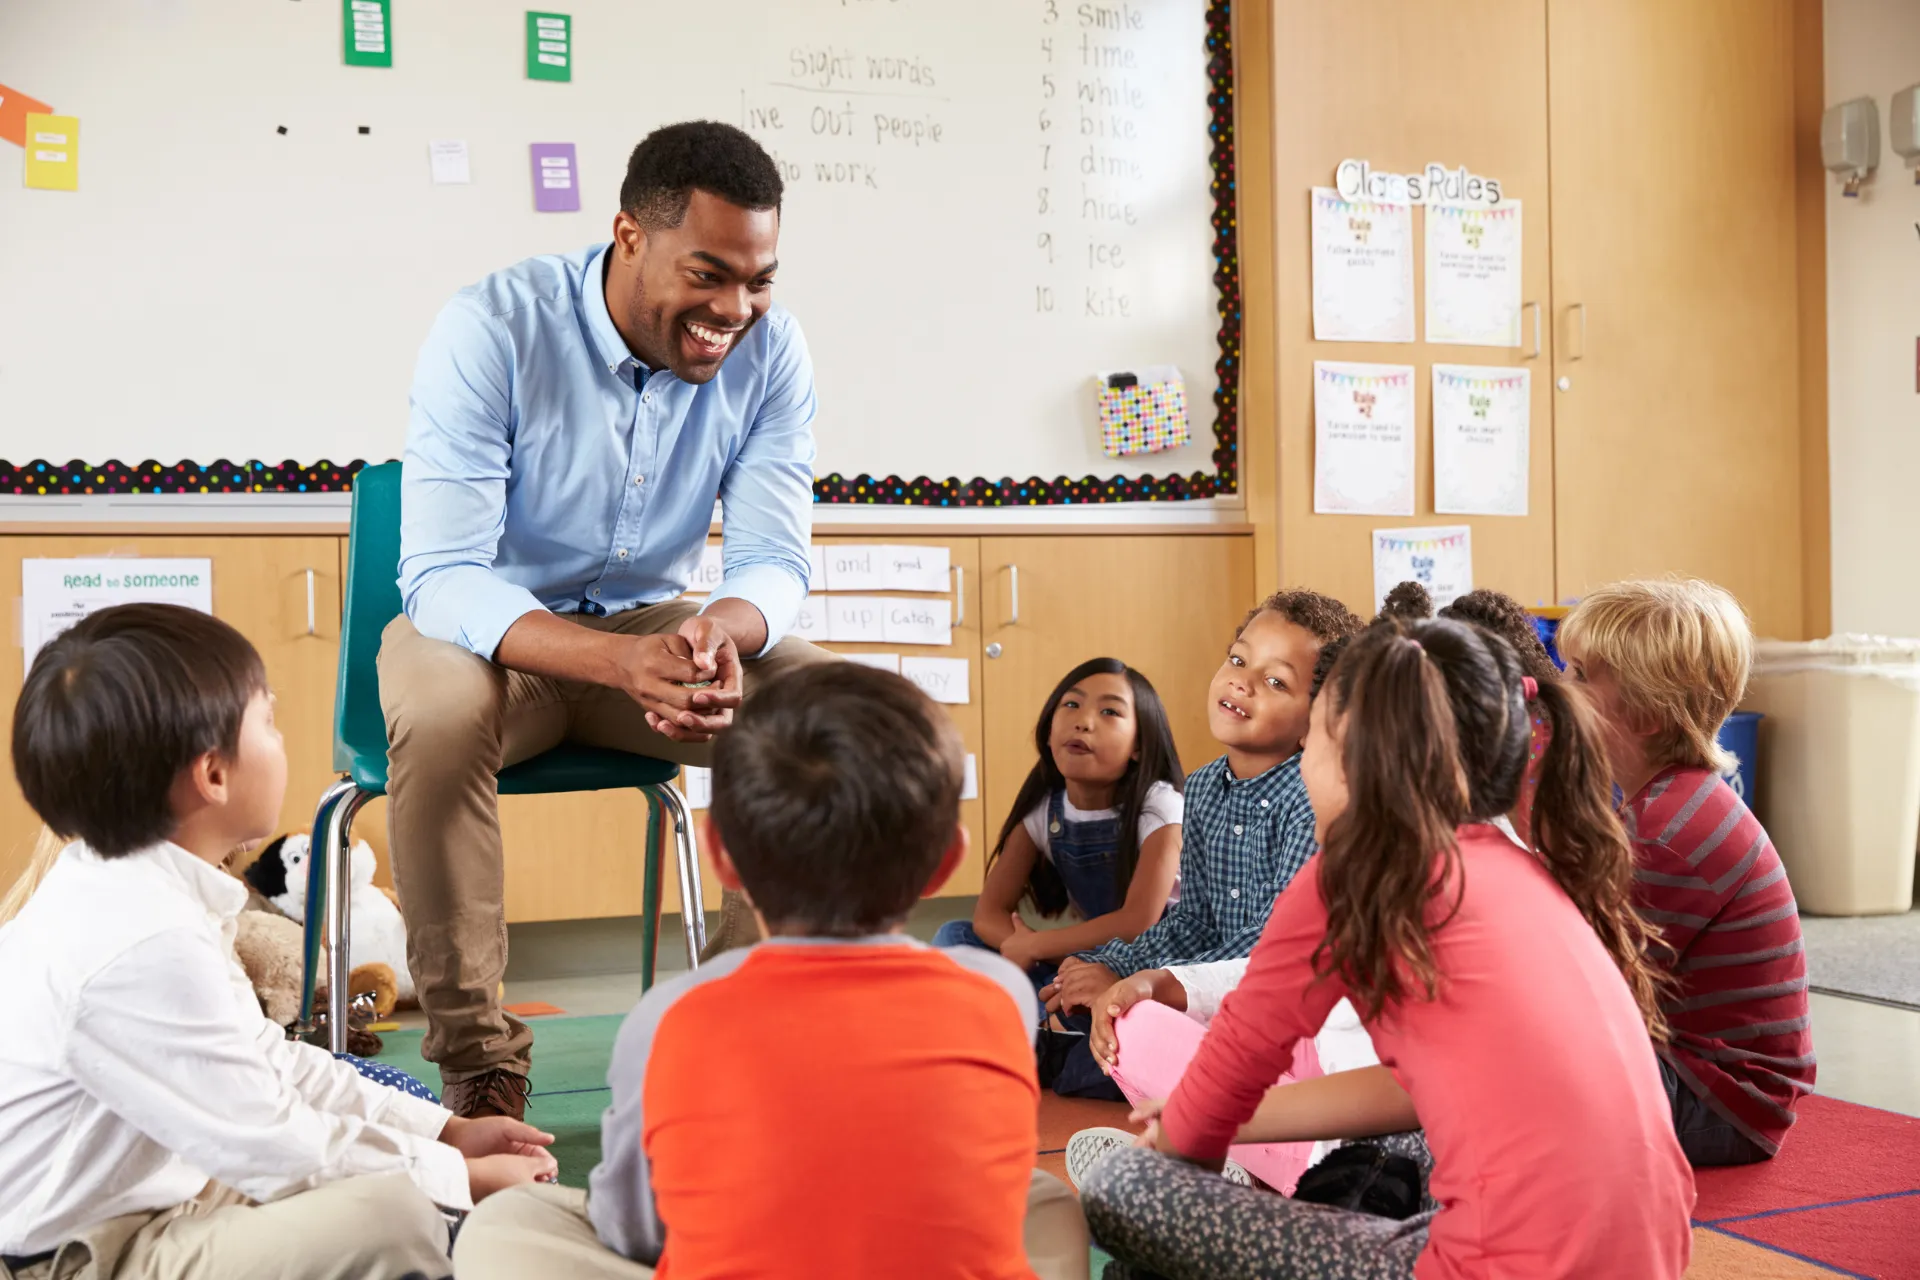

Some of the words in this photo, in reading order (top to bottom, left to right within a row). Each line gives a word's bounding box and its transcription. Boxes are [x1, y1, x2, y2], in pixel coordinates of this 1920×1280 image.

[1078, 33, 1137, 69] time
[866, 55, 936, 87] words
[1078, 77, 1145, 109] while
[740, 88, 784, 129] live
[874, 113, 943, 147] people
[1080, 104, 1137, 139] bike
[773, 150, 801, 183] ho
[815, 162, 878, 190] work
[1080, 145, 1143, 179] dime
[1429, 165, 1501, 204] Rules
[1088, 234, 1125, 270] ice
[1085, 285, 1132, 318] kite
[835, 550, 872, 574] and
[63, 572, 102, 589] Read
[123, 574, 200, 588] someone
[842, 608, 873, 629] up
